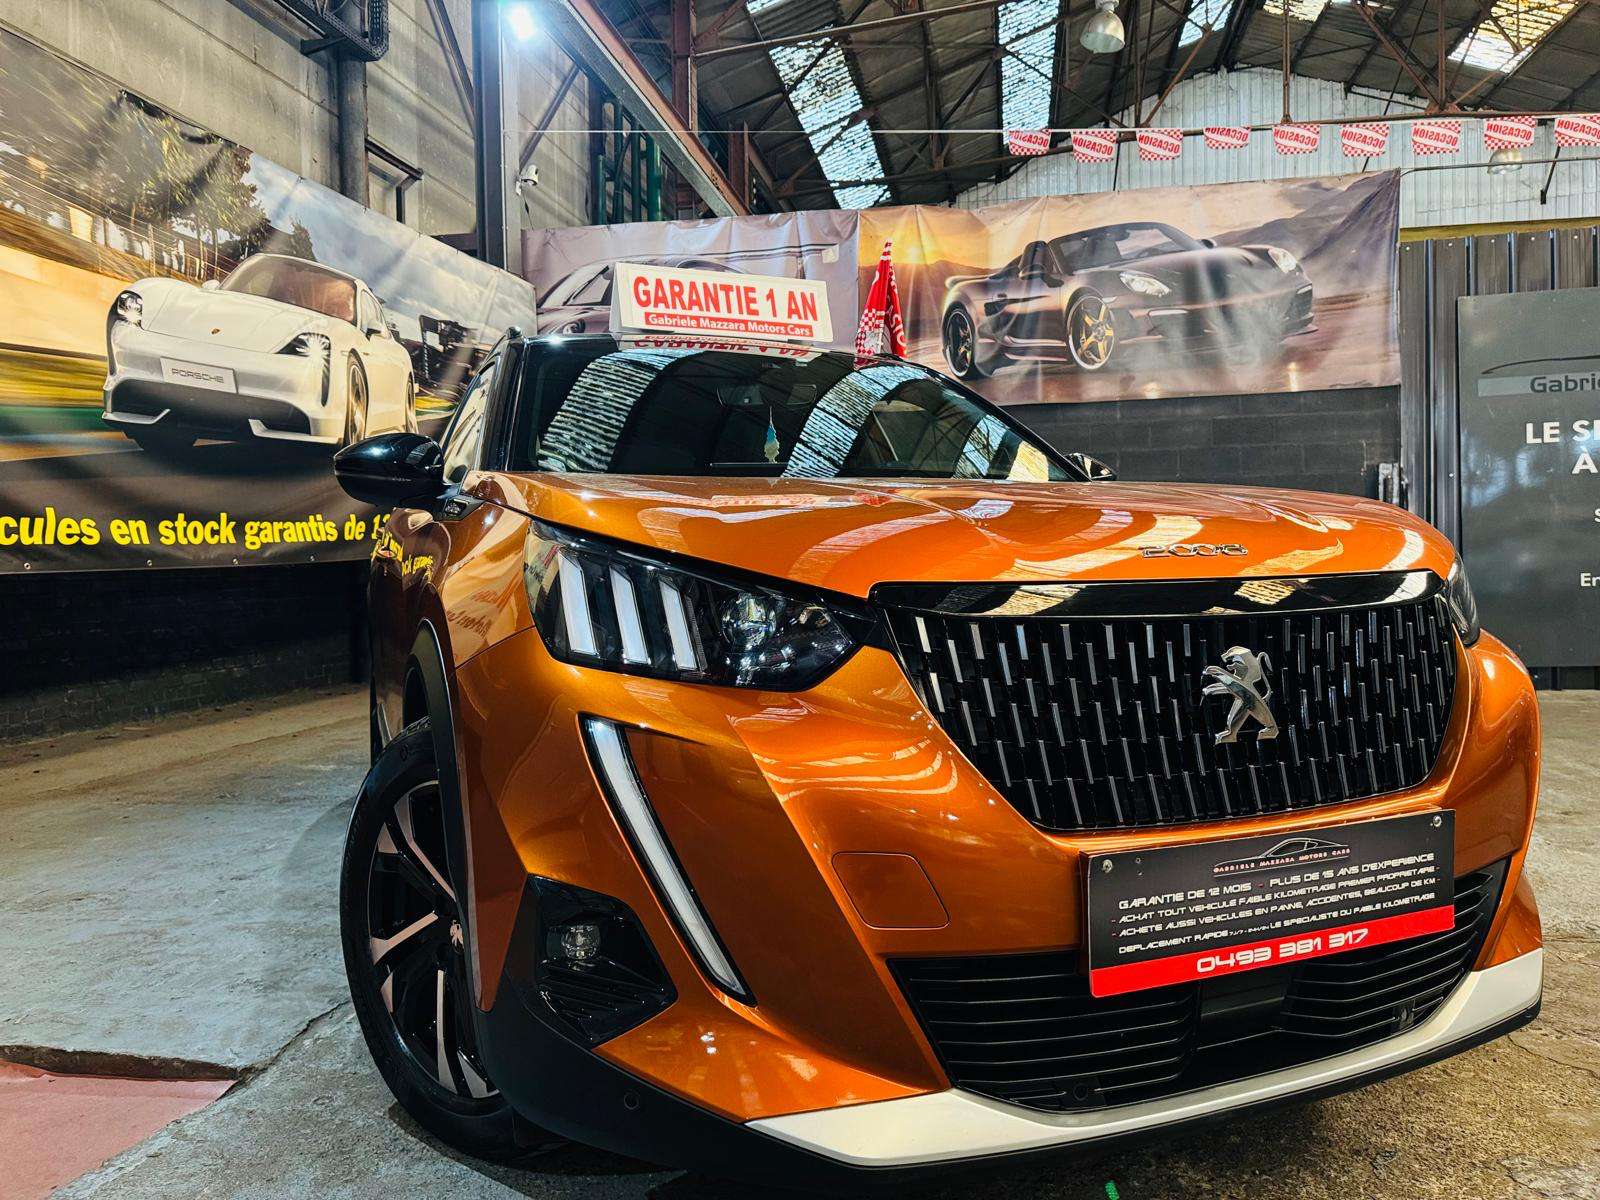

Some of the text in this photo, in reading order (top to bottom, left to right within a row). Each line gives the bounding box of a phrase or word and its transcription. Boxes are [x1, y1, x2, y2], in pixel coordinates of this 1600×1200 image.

[633, 275, 818, 321] GARANTIE 1 AN
[648, 314, 811, 337] Gabriele Mazzara Motors Cars
[171, 368, 224, 384] PORSCHE
[1529, 373, 1600, 393] Gabri
[1525, 421, 1560, 444] LE
[0, 507, 101, 545] cules
[109, 518, 150, 545] en
[158, 512, 237, 545] stock
[244, 513, 338, 550] garantis
[344, 514, 366, 541] de
[1119, 852, 1435, 910] GARANTIE DE 12 MOIS PLUS DE 15 ANS D'EXPERIENCE
[1119, 912, 1155, 924] ACHAT
[1157, 907, 1187, 918] TOUT
[1188, 899, 1237, 913] VEHICULE
[1238, 893, 1272, 906] FAIBLE
[1274, 883, 1336, 899] KILOMETRAGE
[1338, 876, 1375, 889] PREMIER
[1119, 923, 1163, 937] ACHETE
[1165, 918, 1196, 930] AUSSI
[1198, 910, 1253, 924] VEHICULES
[1254, 907, 1269, 916] EN
[1364, 881, 1409, 896] BEAUCOUP
[1410, 880, 1422, 888] DE
[1423, 877, 1436, 885] KM
[1119, 935, 1192, 954] DEPLACEMENT
[1194, 929, 1228, 941] RAPIDE
[1270, 921, 1282, 929] LE
[1339, 908, 1352, 916] DU
[1382, 892, 1435, 909] KILOMETRAGE
[1196, 928, 1369, 973] 0493 381 317
